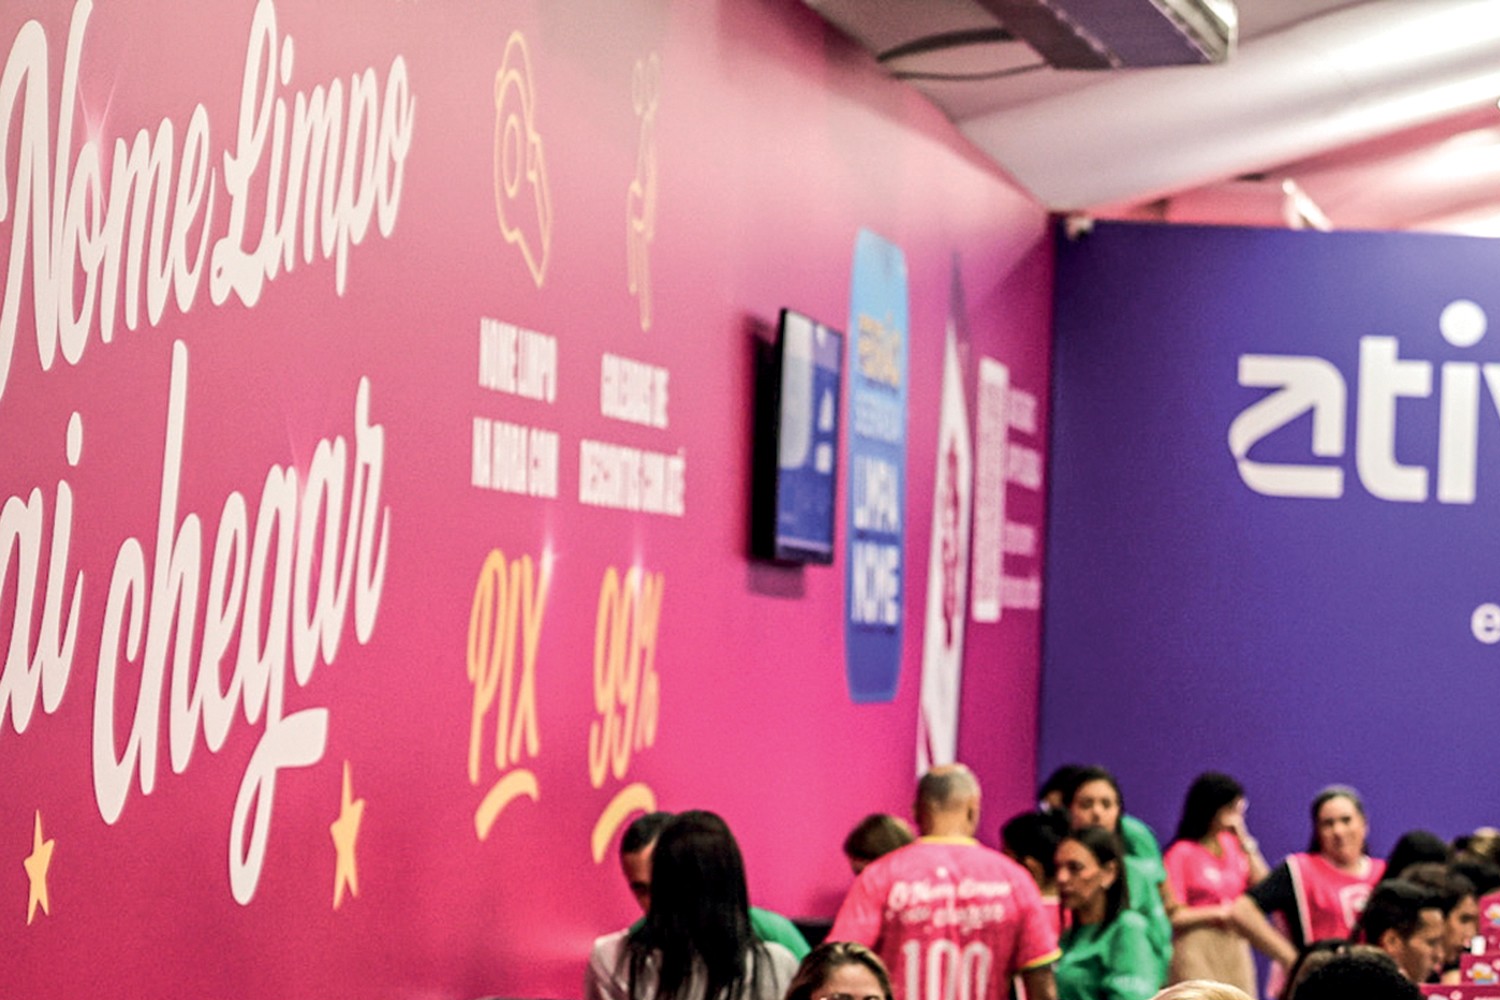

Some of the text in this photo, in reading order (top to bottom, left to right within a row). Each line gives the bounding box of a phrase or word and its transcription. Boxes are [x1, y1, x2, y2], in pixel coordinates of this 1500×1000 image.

[0, 0, 415, 400] Nome Limpo
[93, 339, 390, 905] chegar
[467, 545, 554, 785] PIX
